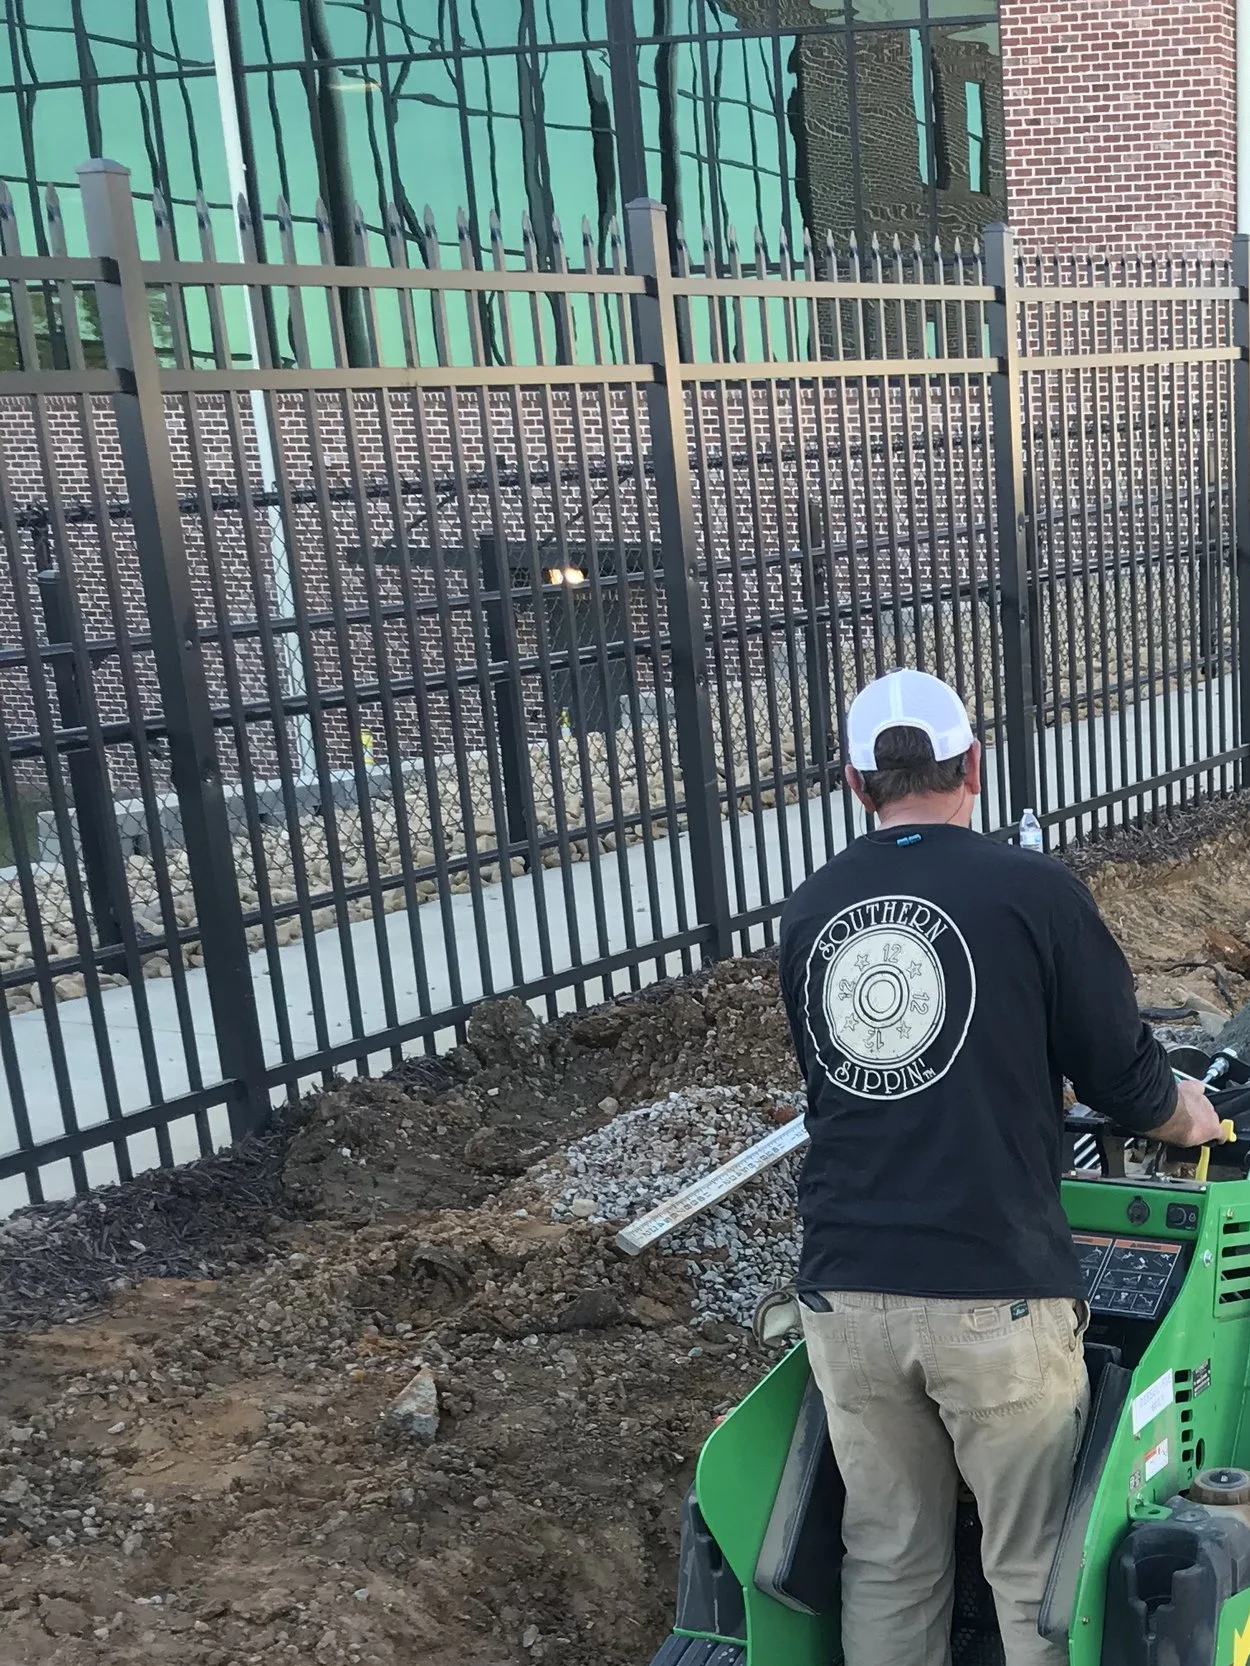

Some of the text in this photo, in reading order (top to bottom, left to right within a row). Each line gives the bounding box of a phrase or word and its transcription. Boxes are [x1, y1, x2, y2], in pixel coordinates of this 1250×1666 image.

[818, 901, 949, 960] SOUTHERN
[883, 943, 902, 963] 12
[910, 991, 930, 1015] 12
